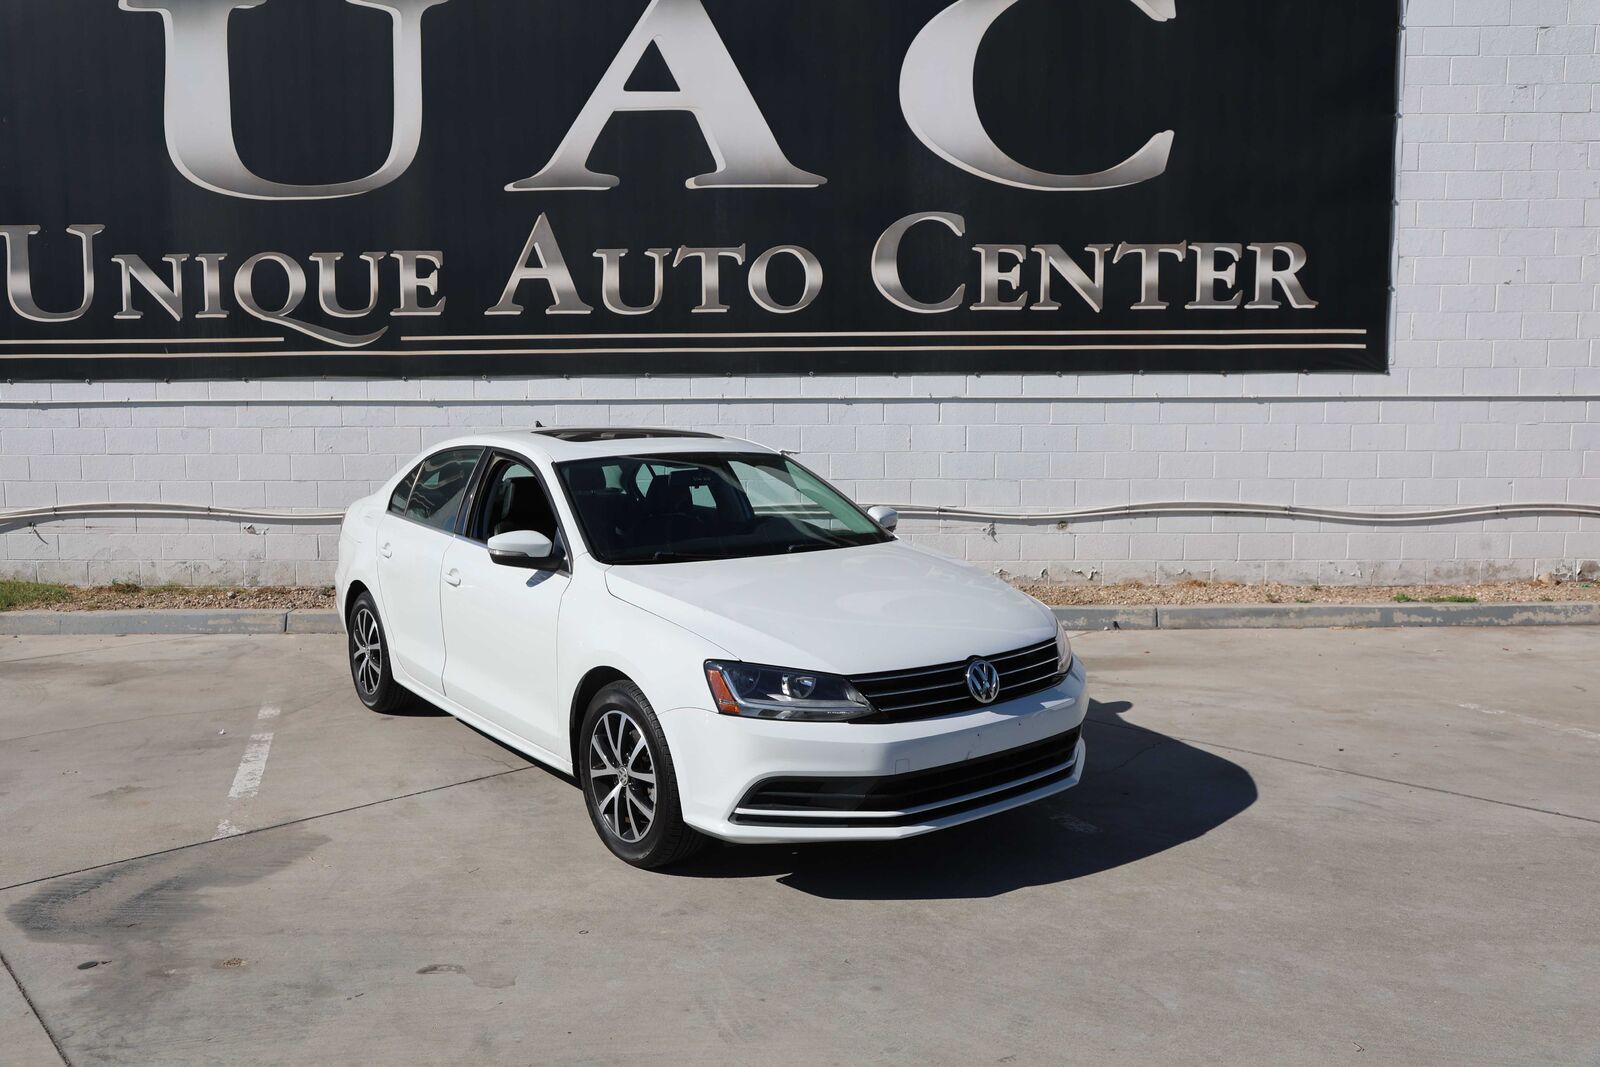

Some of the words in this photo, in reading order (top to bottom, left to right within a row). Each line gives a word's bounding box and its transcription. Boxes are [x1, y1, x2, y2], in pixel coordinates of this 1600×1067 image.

[0, 223, 446, 347] UNIQUE
[484, 211, 824, 316] AUTO
[871, 211, 1319, 315] CENTER
